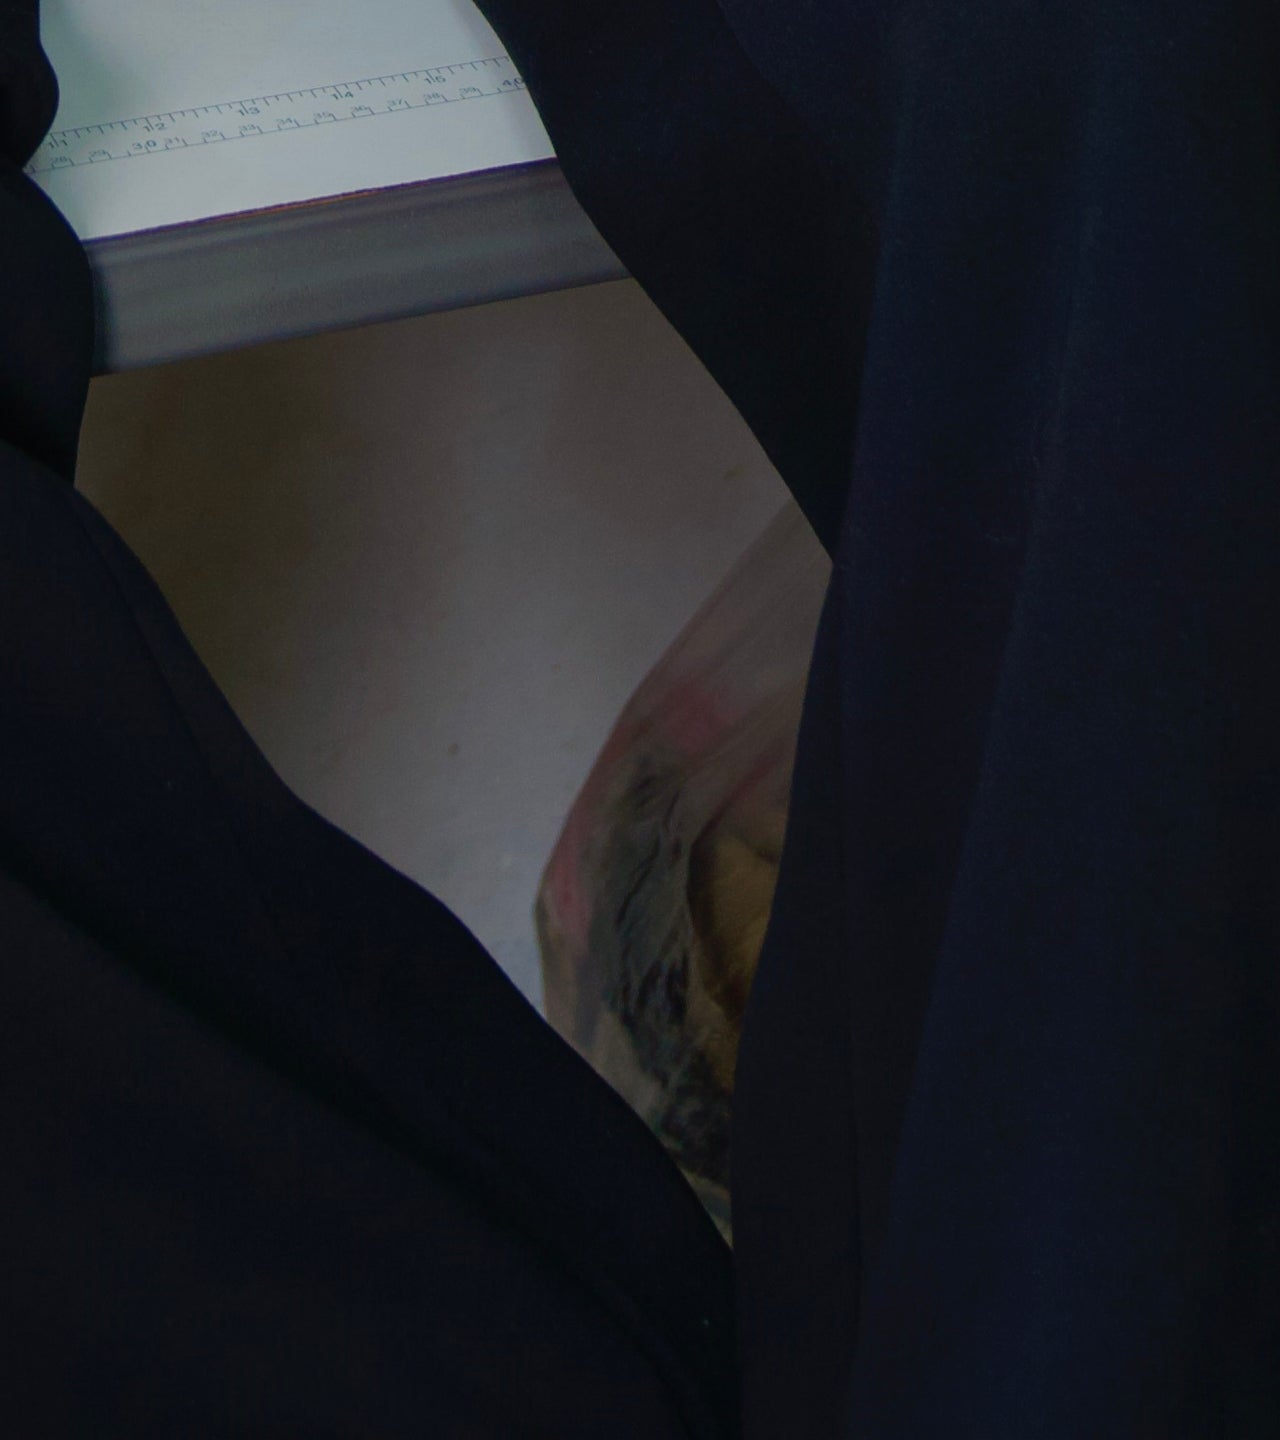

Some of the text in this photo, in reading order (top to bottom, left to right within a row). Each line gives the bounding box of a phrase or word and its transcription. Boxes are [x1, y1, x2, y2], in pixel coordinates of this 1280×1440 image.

[142, 123, 166, 133] 12
[238, 107, 261, 116] 13
[331, 91, 354, 100] 14
[424, 75, 446, 85] 15
[132, 139, 157, 150] 30
